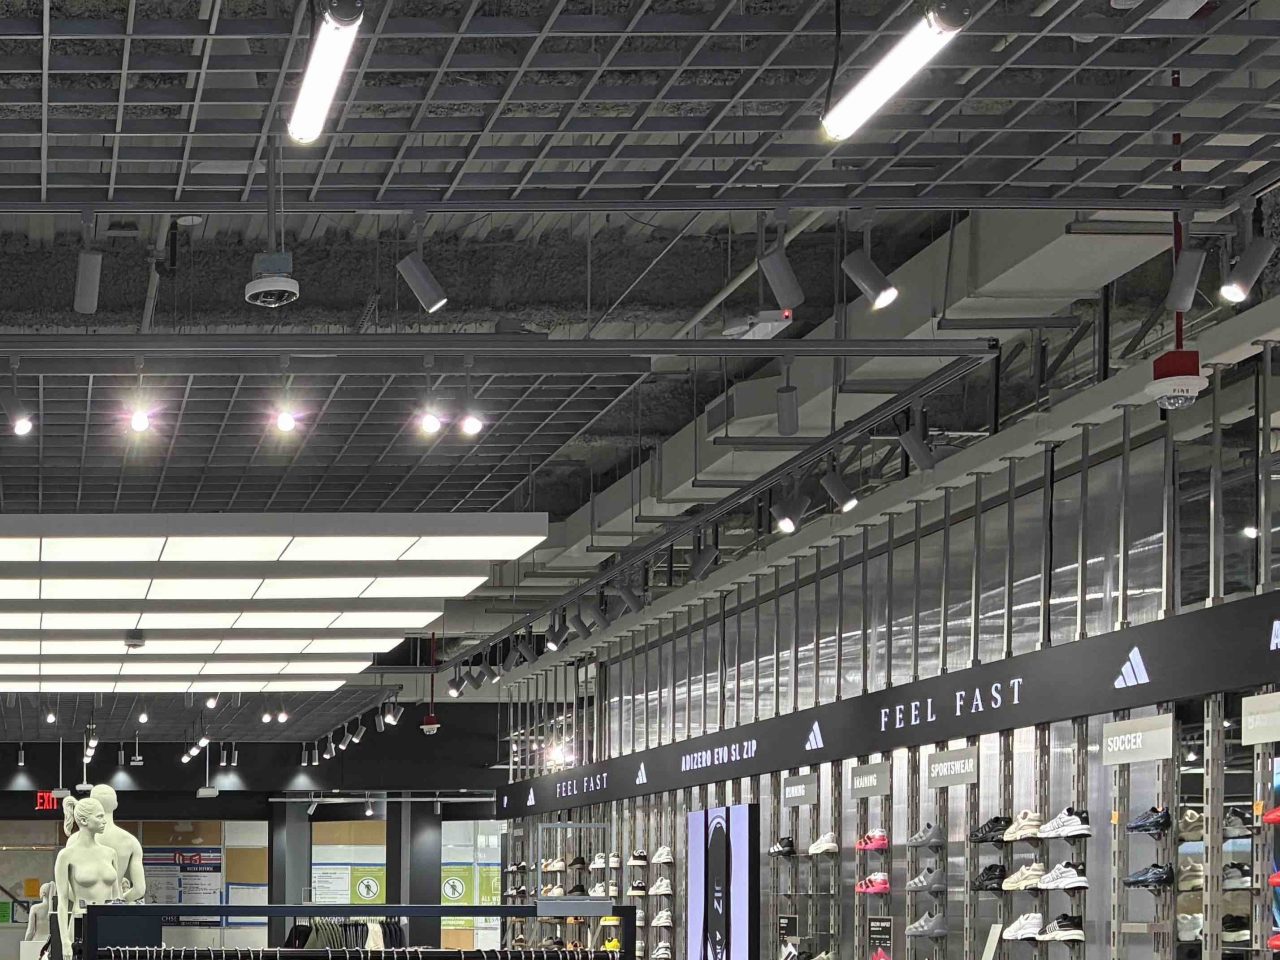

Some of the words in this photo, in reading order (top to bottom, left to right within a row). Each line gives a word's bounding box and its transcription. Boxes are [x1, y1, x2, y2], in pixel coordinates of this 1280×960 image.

[880, 698, 937, 732] FEEL
[955, 678, 1023, 717] FAST
[1107, 732, 1142, 753] SOCCER
[681, 749, 712, 772] ADIZERO
[714, 745, 728, 765] EVO
[730, 743, 740, 762] SL
[743, 739, 757, 759] ZIP
[930, 757, 974, 779] SPORTSWEAR
[556, 779, 578, 799] FEEL
[583, 772, 608, 793] FAST
[854, 773, 878, 790] TRAINING
